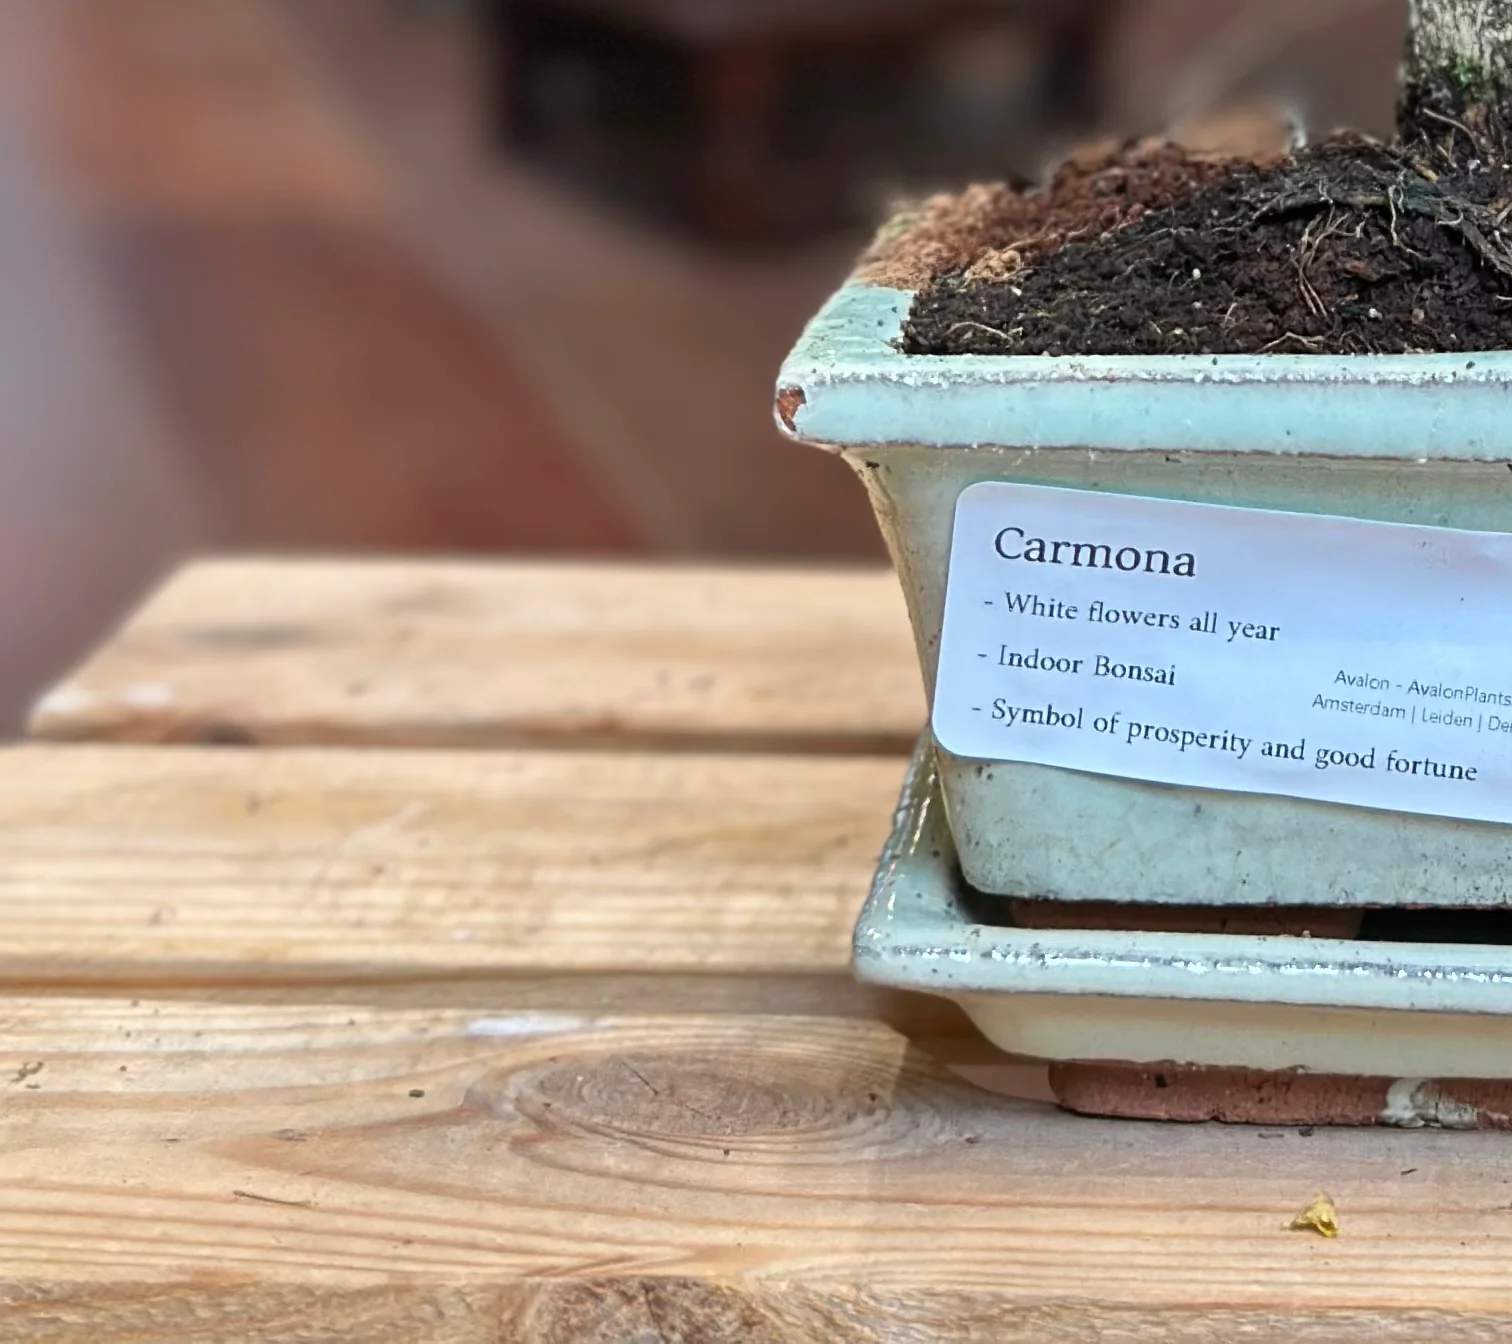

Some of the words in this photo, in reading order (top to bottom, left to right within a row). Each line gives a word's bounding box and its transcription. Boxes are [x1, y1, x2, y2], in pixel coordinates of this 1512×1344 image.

[994, 526, 1197, 577] Carmona
[1004, 592, 1079, 621] White
[1087, 600, 1180, 629] flowers
[1189, 611, 1218, 634] all
[1226, 619, 1281, 643] year
[998, 644, 1084, 675] Indoor
[1093, 654, 1177, 686] Bonsai
[1333, 668, 1391, 691] Avalon
[1312, 693, 1407, 721] Amsterdam
[1421, 707, 1474, 729] Leiden
[991, 698, 1084, 731] Symbol
[1093, 711, 1122, 735] of
[1126, 719, 1253, 760] prosperity
[1260, 738, 1306, 761] and
[1315, 747, 1376, 771] good
[1386, 750, 1479, 782] fortune
